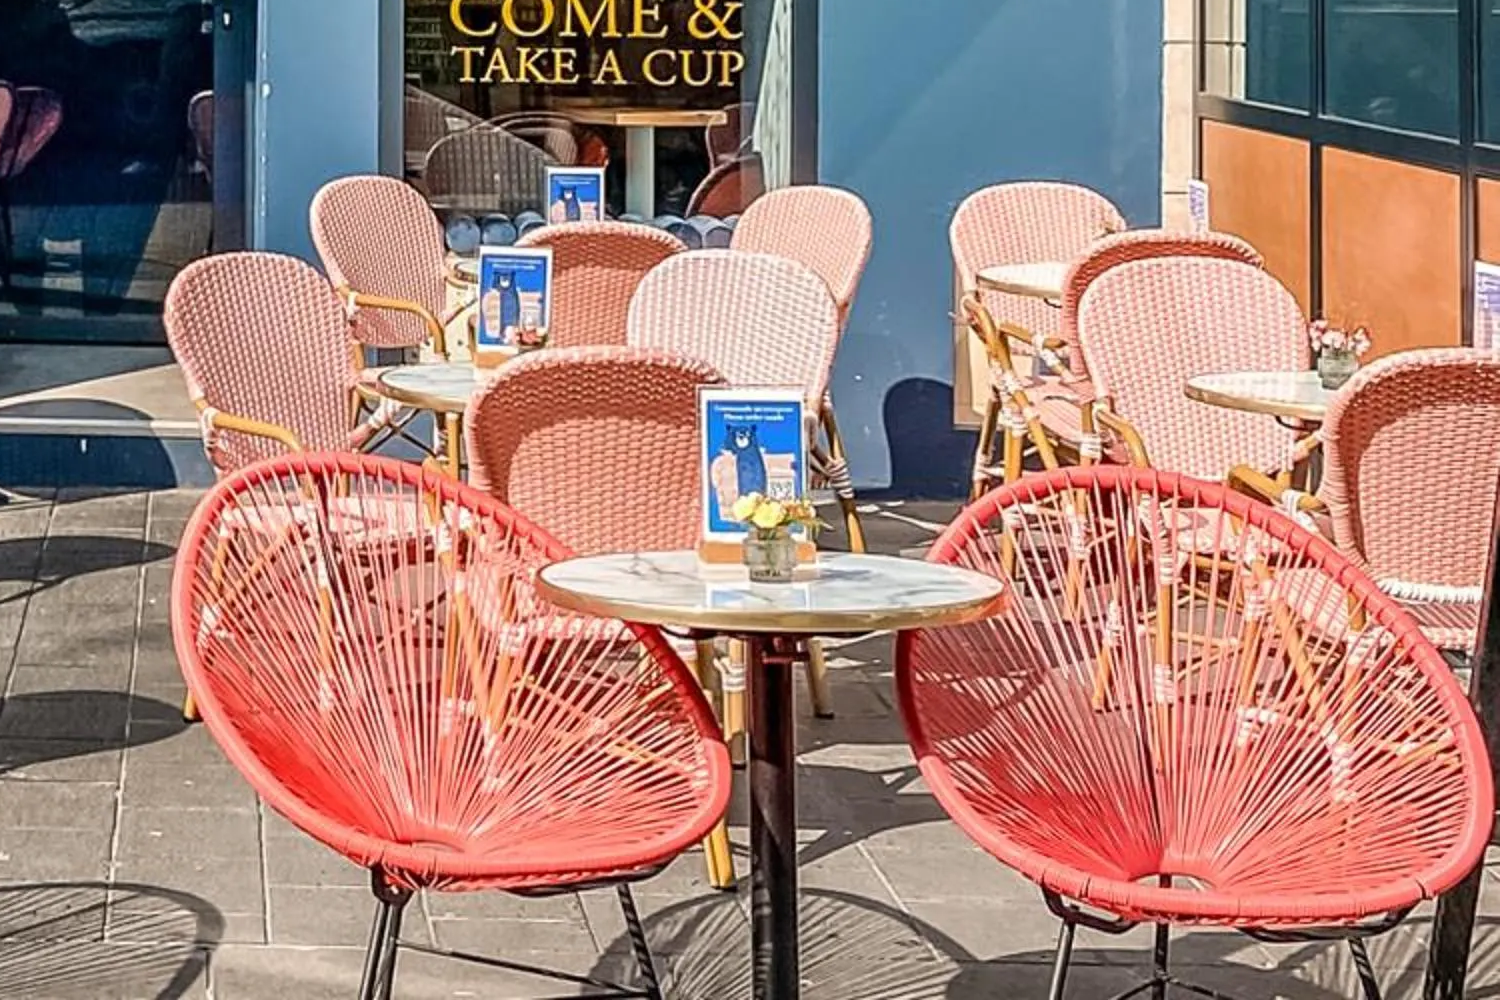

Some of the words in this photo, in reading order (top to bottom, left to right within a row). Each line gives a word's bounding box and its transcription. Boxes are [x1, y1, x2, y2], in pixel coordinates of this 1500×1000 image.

[450, 46, 580, 84] TAKE
[592, 47, 628, 85] A
[642, 49, 745, 87] CUP
